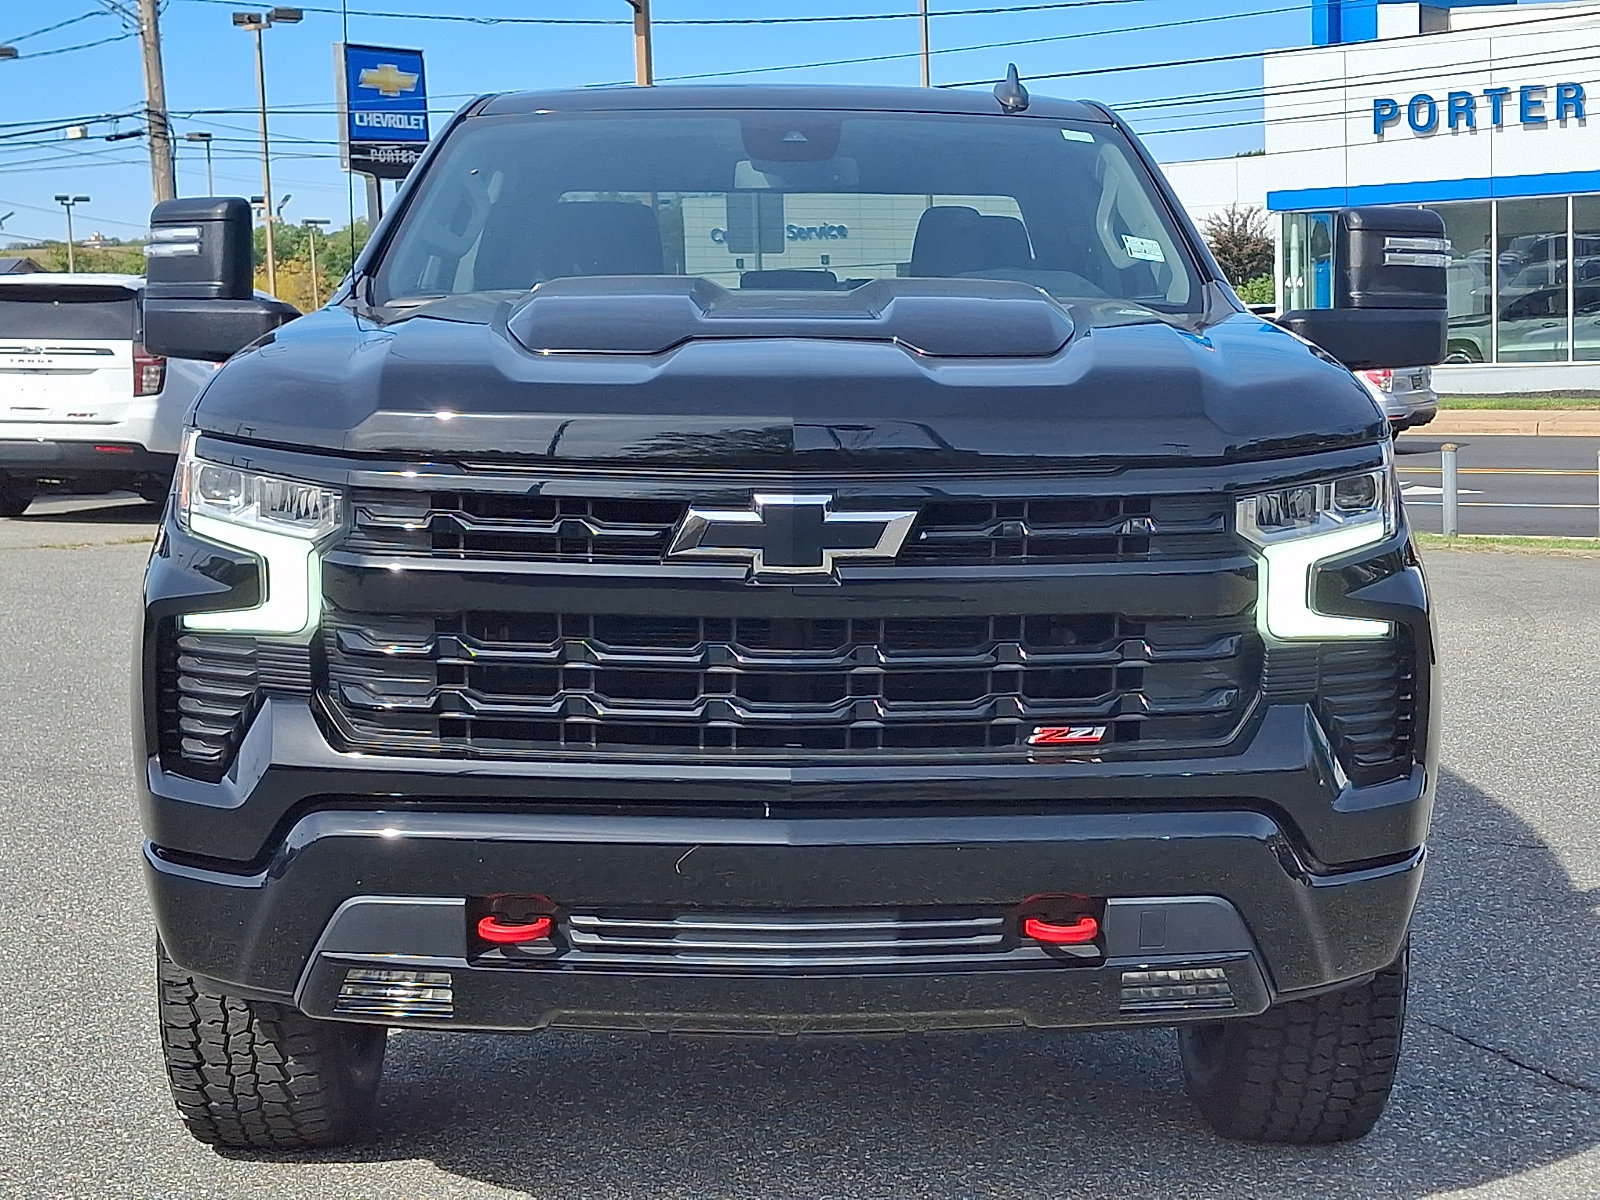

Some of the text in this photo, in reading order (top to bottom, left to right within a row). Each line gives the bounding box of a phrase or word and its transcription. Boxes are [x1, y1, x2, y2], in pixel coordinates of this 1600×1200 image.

[1373, 82, 1586, 135] PORTER
[354, 112, 425, 130] CHEVROLET
[370, 148, 418, 163] PORTER
[786, 222, 849, 241] Service
[1284, 276, 1304, 288] 44
